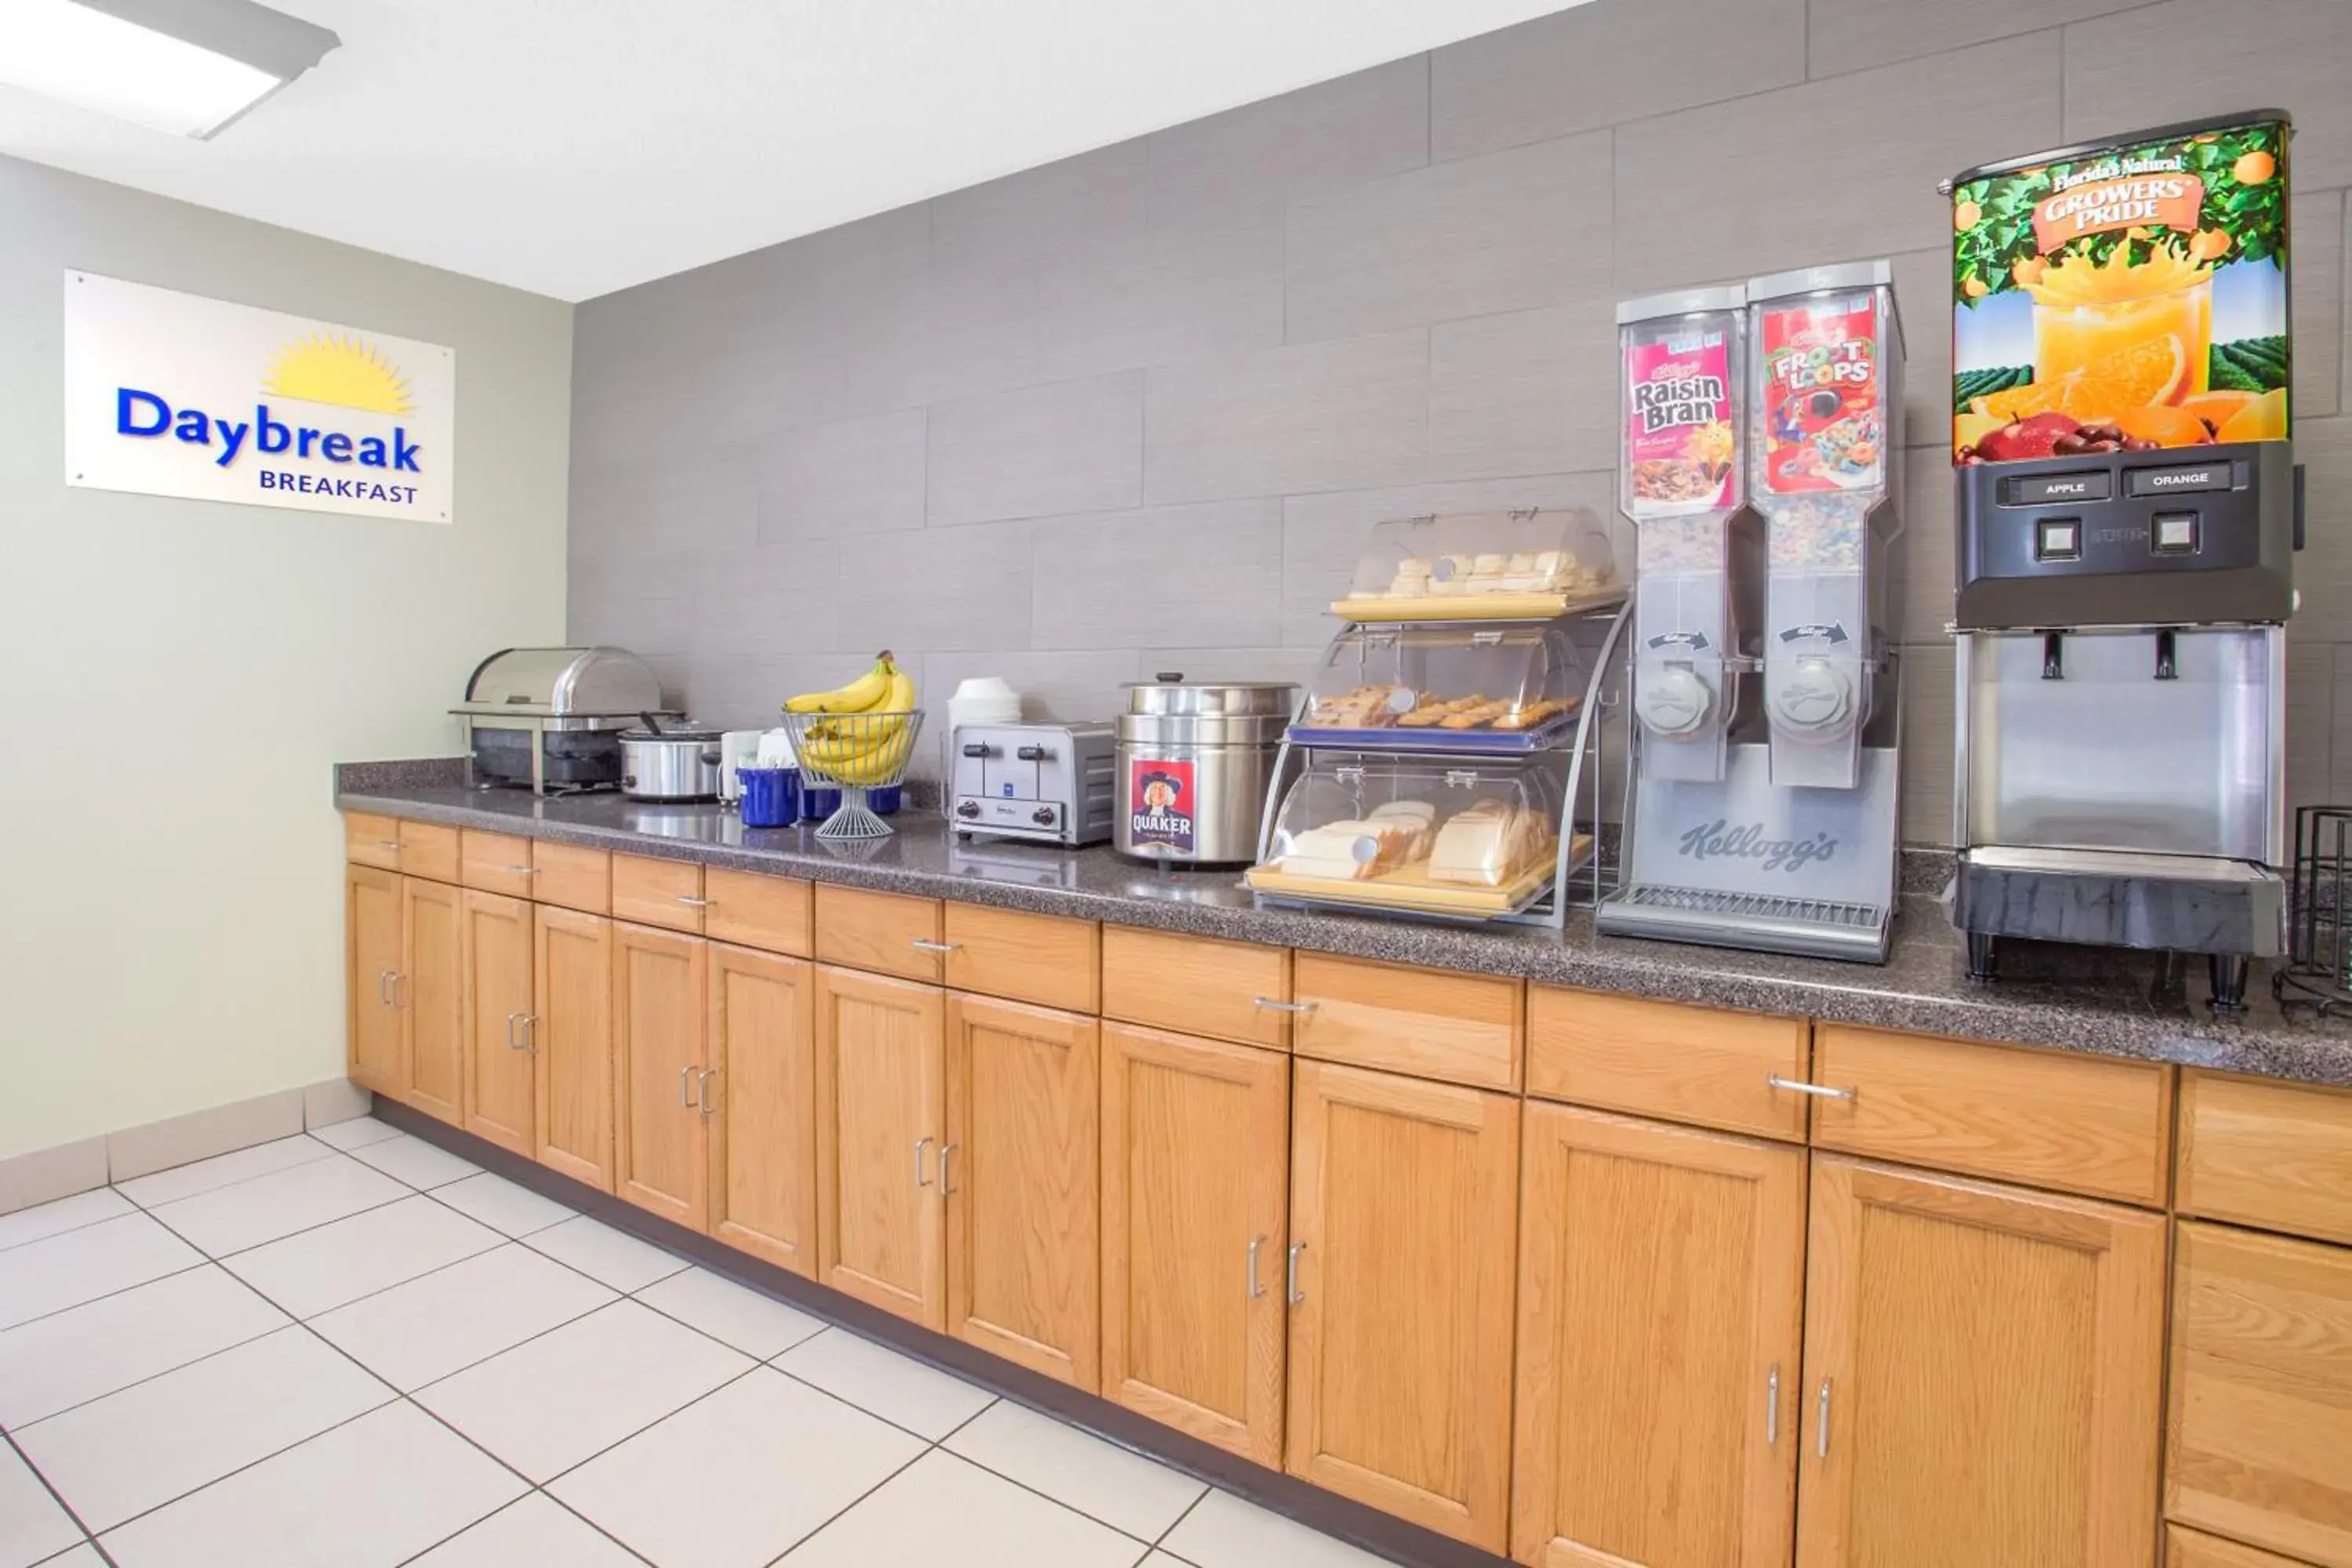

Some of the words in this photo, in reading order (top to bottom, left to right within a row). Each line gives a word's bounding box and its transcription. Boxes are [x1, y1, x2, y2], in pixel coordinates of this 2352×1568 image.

[2121, 154, 2183, 178] Natural
[2076, 199, 2160, 230] PRIDE
[1776, 341, 1862, 378] FROOT
[1790, 361, 1870, 390] LOOPS
[1635, 378, 1722, 411] Raisin
[118, 387, 422, 473] Daybreak
[1646, 401, 1714, 430] Bran
[260, 470, 418, 505] BREAKFAST
[2045, 483, 2085, 494] APPLE
[2153, 473, 2209, 486] ORANGE
[1133, 815, 1191, 834] QUAKER
[1679, 818, 1838, 873] Kellogg's
